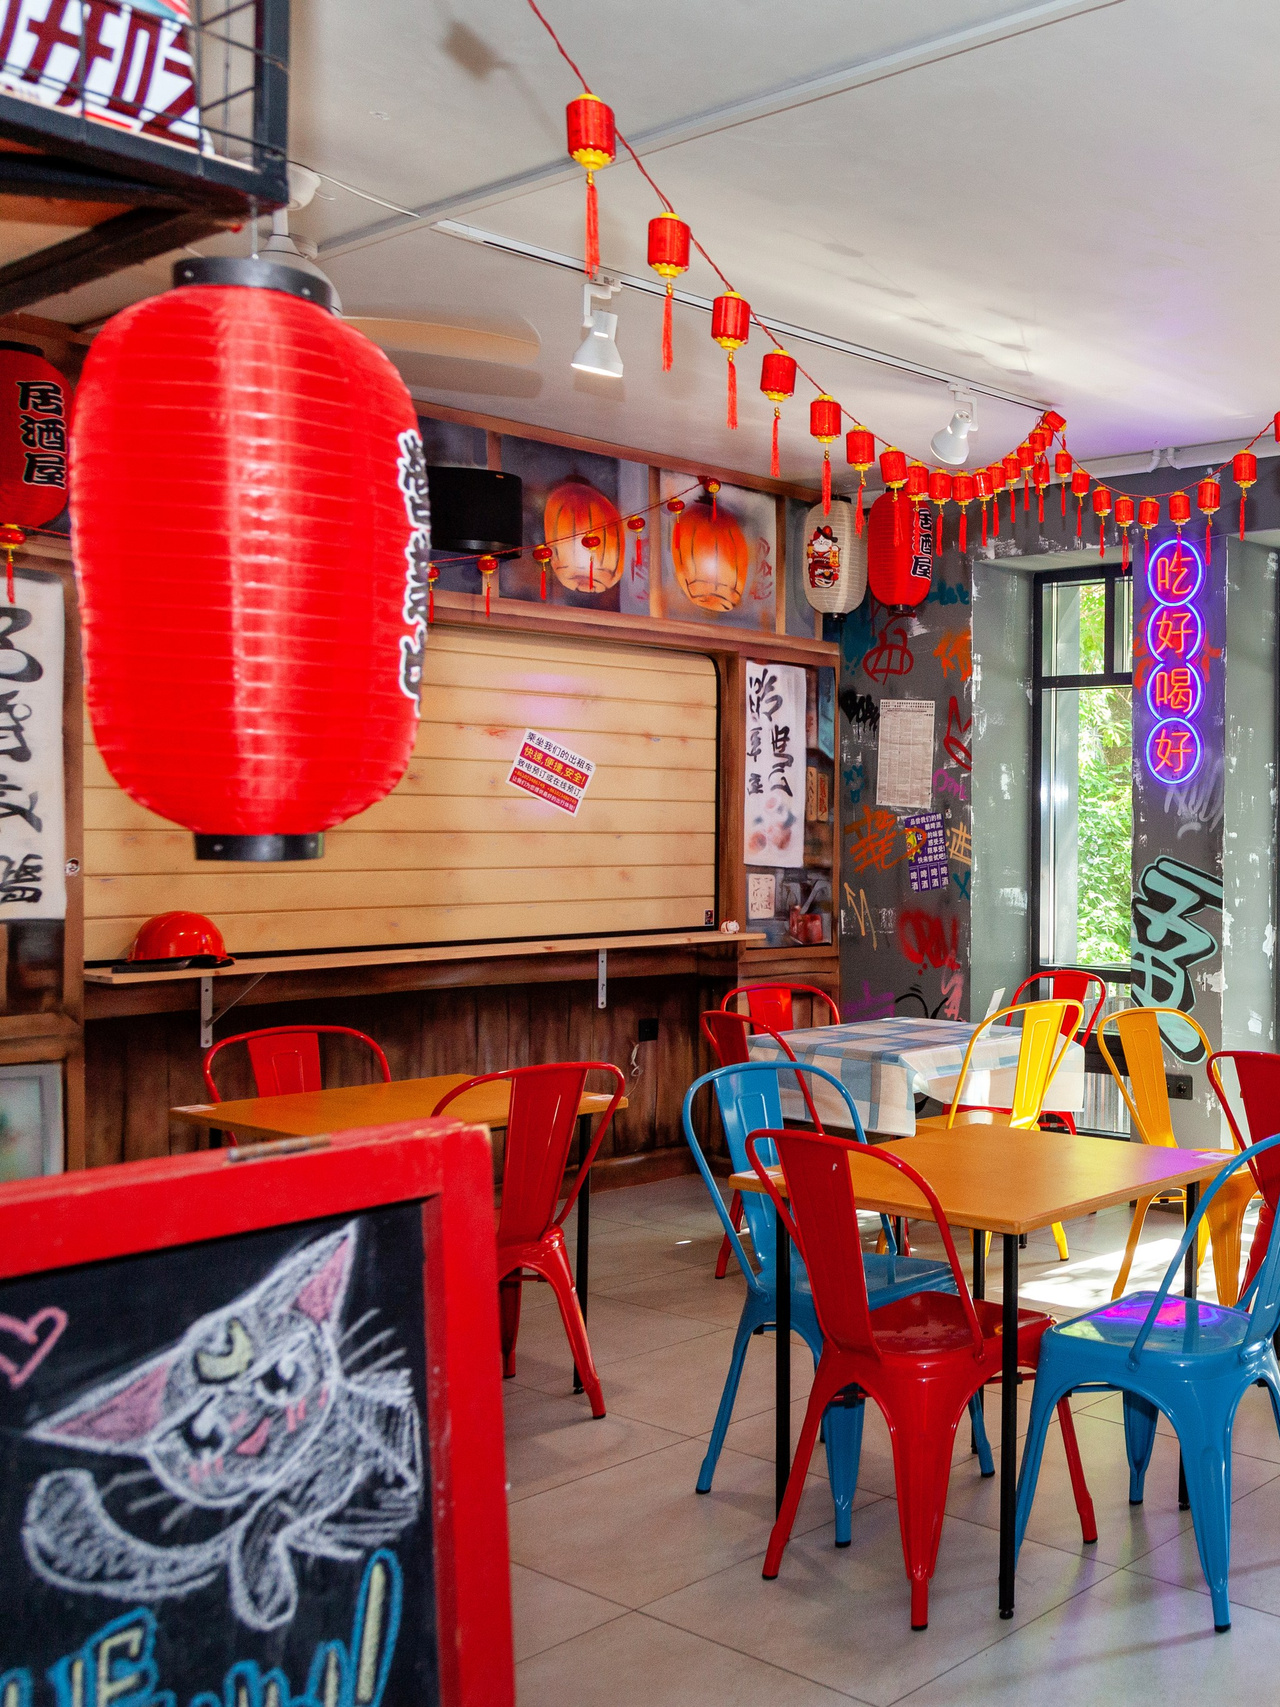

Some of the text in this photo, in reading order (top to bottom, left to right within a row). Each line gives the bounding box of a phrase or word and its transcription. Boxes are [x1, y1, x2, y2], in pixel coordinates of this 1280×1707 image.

[15, 380, 67, 490] 居酒屋
[1154, 551, 1196, 774] 吃好喝好
